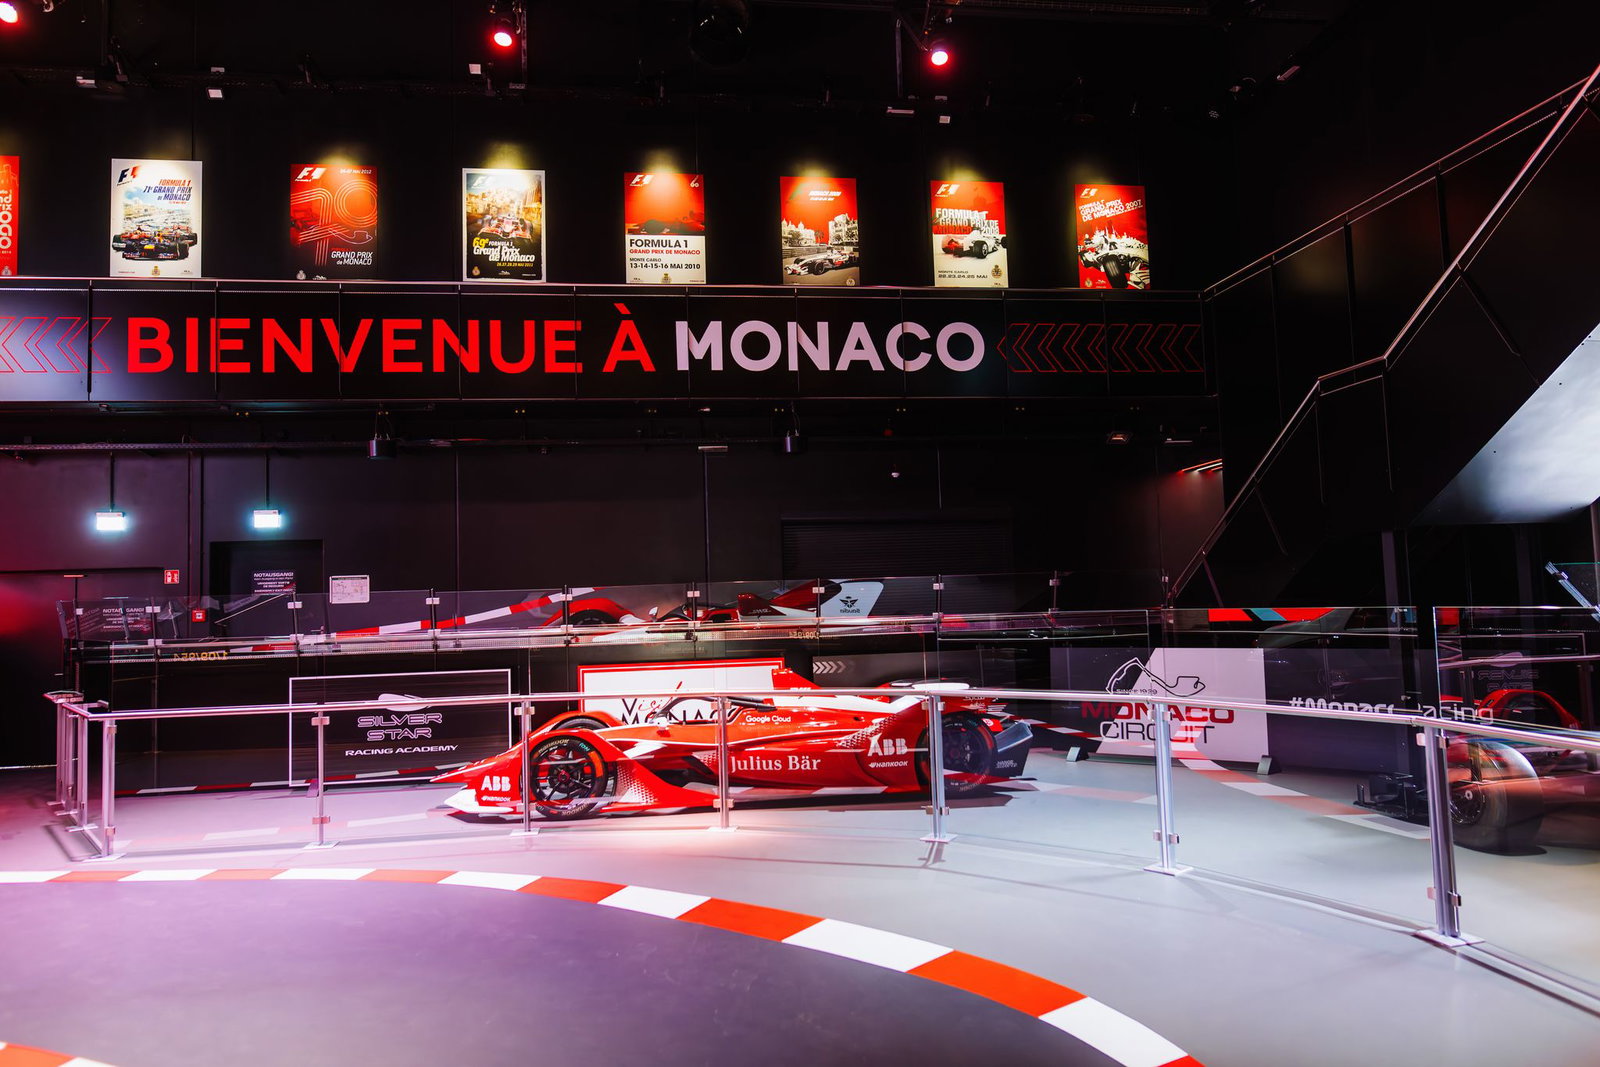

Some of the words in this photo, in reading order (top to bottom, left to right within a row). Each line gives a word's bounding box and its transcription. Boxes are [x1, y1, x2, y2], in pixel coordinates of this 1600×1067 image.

[630, 239, 682, 248] FORMULA
[684, 240, 688, 248] 1
[356, 251, 373, 259] PRIX
[127, 316, 583, 374] BIENVENUE
[602, 302, 656, 373] À
[675, 319, 986, 372] MONACO
[357, 712, 442, 728] SILVER
[745, 715, 770, 724] Google
[367, 727, 432, 741] STAR
[345, 747, 393, 757] RACING
[395, 744, 458, 754] ACADEMY
[867, 738, 908, 757] ABB
[731, 755, 788, 773] Julius
[792, 754, 821, 771] Bär
[481, 775, 511, 792] ABB
